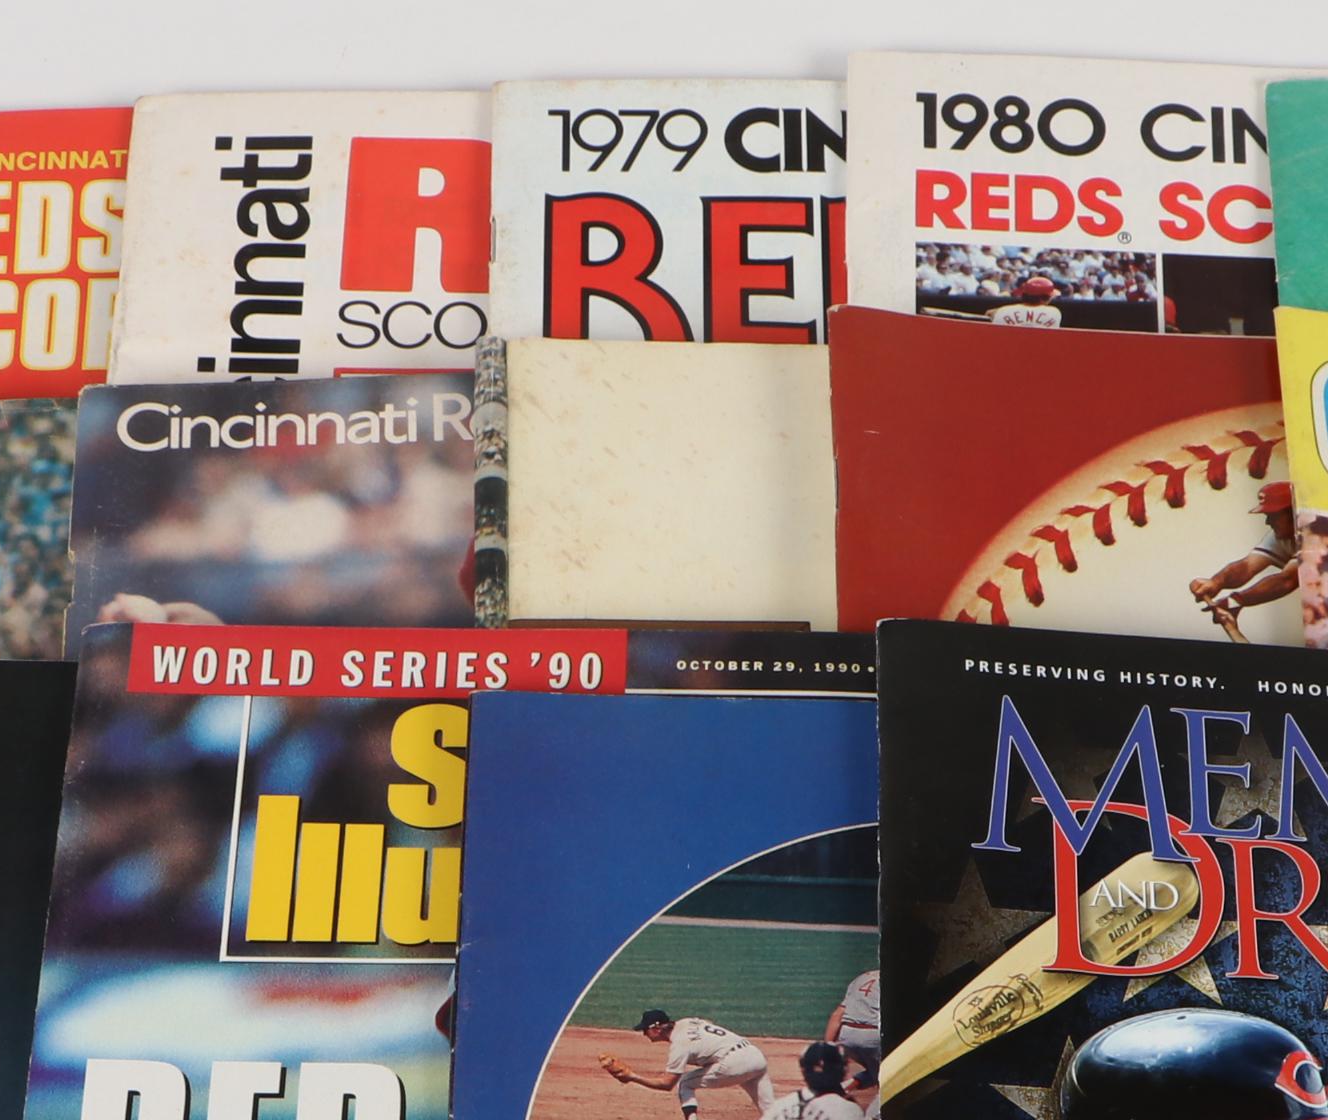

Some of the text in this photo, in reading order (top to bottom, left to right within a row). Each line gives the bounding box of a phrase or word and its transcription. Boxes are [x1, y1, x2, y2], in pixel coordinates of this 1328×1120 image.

[548, 107, 708, 173] 1979
[916, 92, 1106, 156] 1980
[915, 170, 1125, 238] REDS
[336, 300, 488, 350] SCO
[116, 396, 418, 453] Cincinnati
[152, 644, 605, 690] WORLD SERIES '90
[676, 658, 862, 675] OCTOBER 29, 1990
[963, 658, 1108, 683] PRESERVING
[1119, 669, 1227, 691] HISTORY.
[1089, 878, 1180, 911] AND
